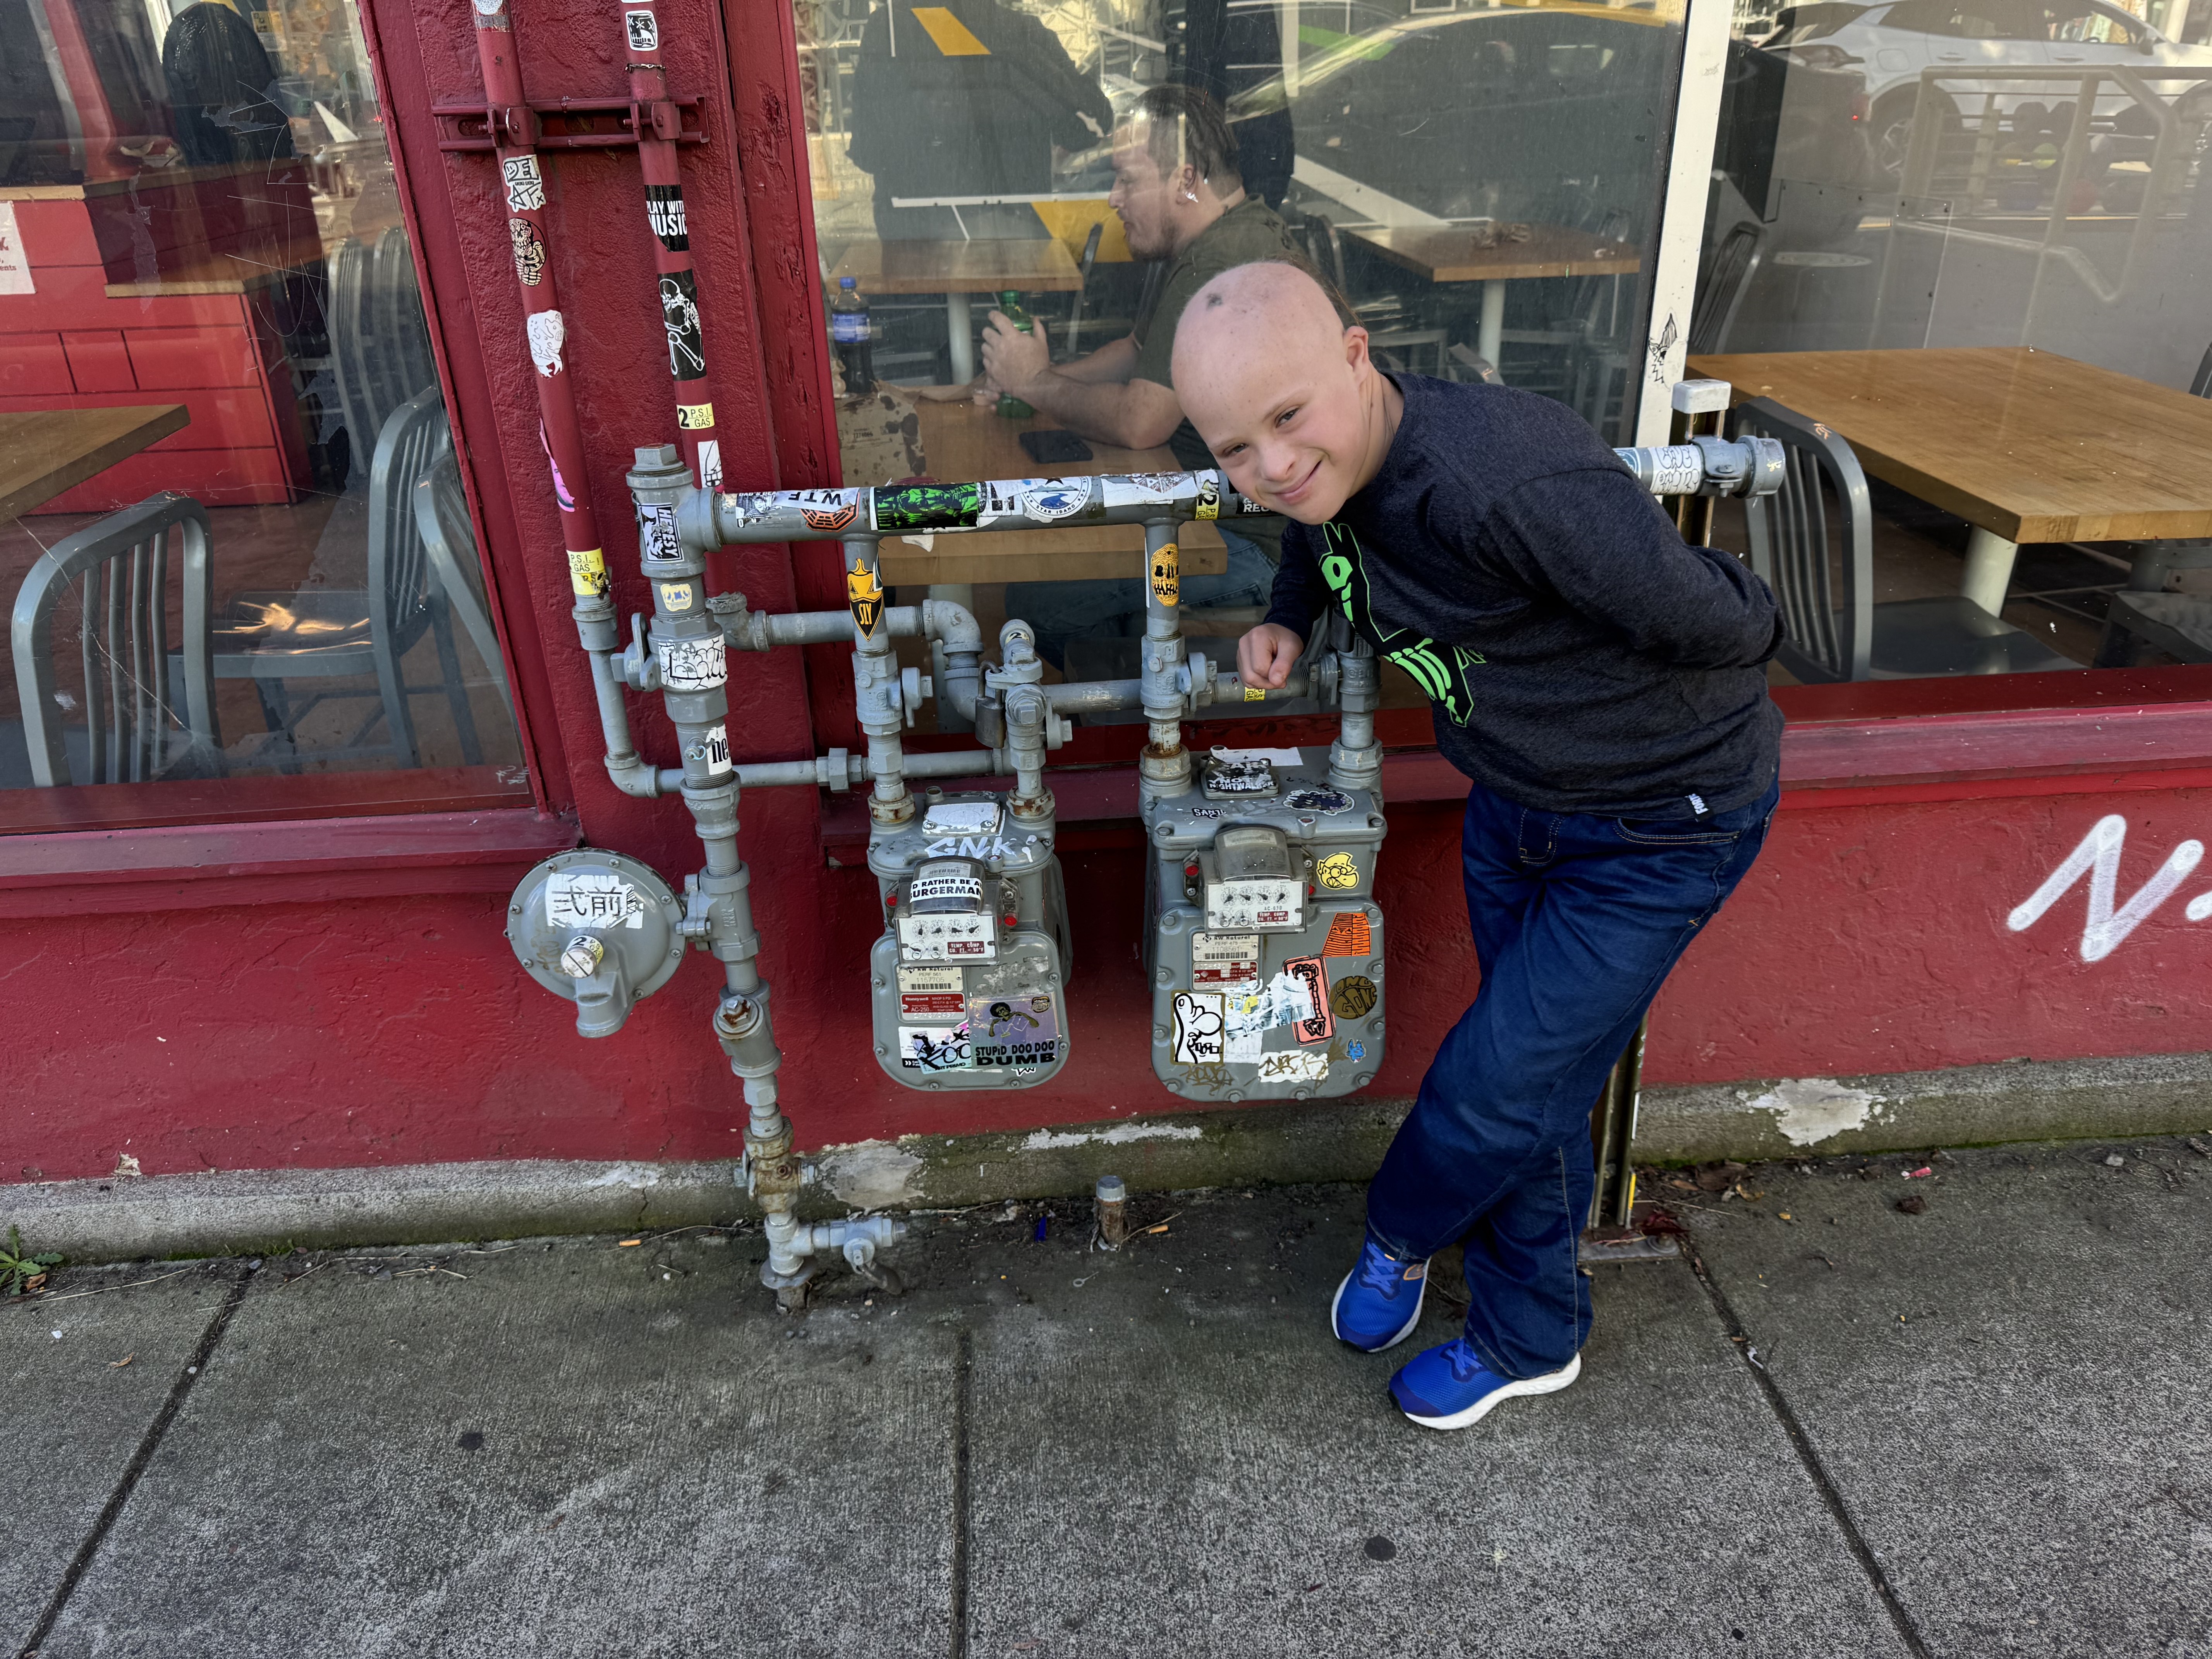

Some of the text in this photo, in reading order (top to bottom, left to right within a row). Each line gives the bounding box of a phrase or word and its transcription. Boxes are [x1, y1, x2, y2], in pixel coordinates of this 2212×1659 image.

[648, 213, 687, 236] MUSIC
[678, 408, 690, 428] 2
[694, 417, 711, 428] GAS
[788, 492, 842, 506] WTF
[1036, 504, 1076, 514] STAR IDAHO
[574, 564, 590, 572] GAS
[859, 603, 872, 625] SLY
[712, 738, 731, 764] ne
[922, 879, 956, 887] RATHER
[570, 937, 587, 947] 2
[1012, 1043, 1032, 1054] DOO
[1035, 1040, 1054, 1053] DOO
[976, 1052, 1055, 1066] DUMB
